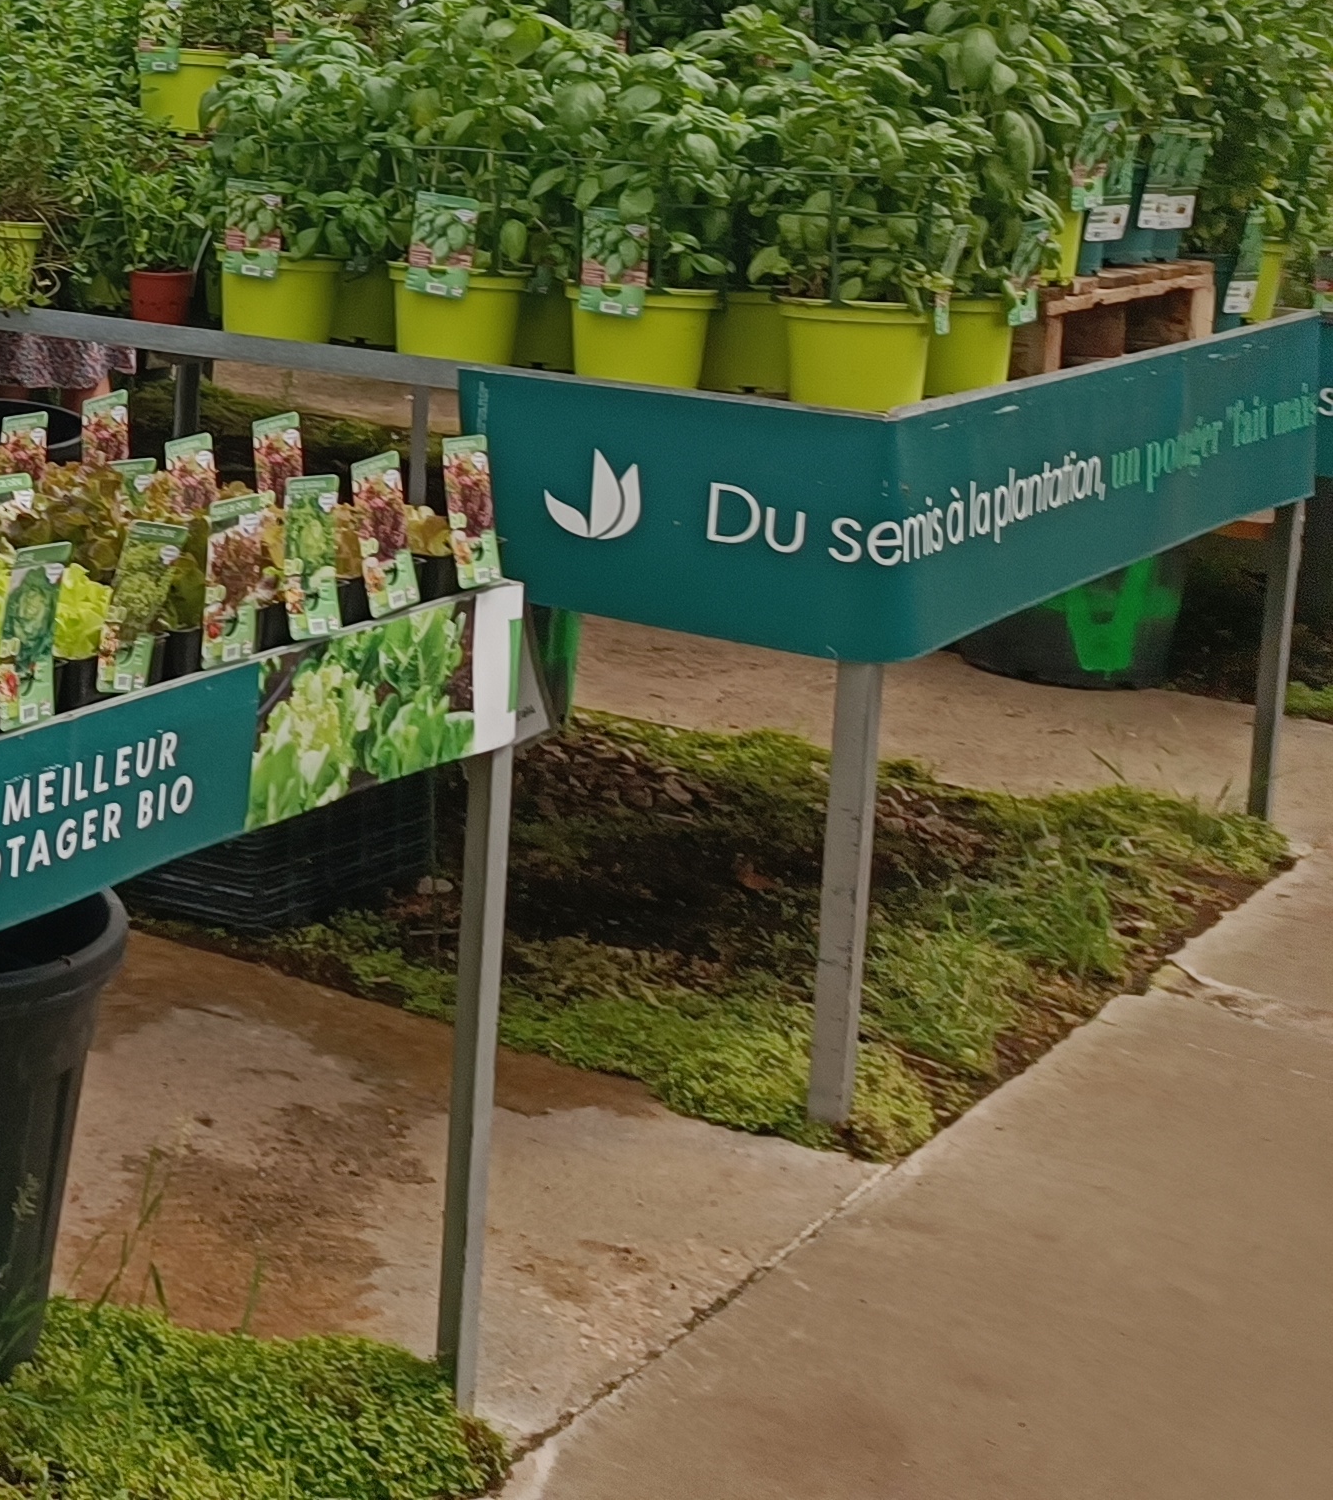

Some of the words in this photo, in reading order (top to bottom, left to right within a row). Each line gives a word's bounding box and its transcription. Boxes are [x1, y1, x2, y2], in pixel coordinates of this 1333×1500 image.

[706, 481, 807, 554] Du
[827, 496, 944, 567] semis
[946, 486, 965, 545] à
[969, 480, 991, 537] la
[994, 451, 1106, 544] plantation,
[2, 731, 178, 826] MEILLEUR
[136, 775, 194, 830] BIO
